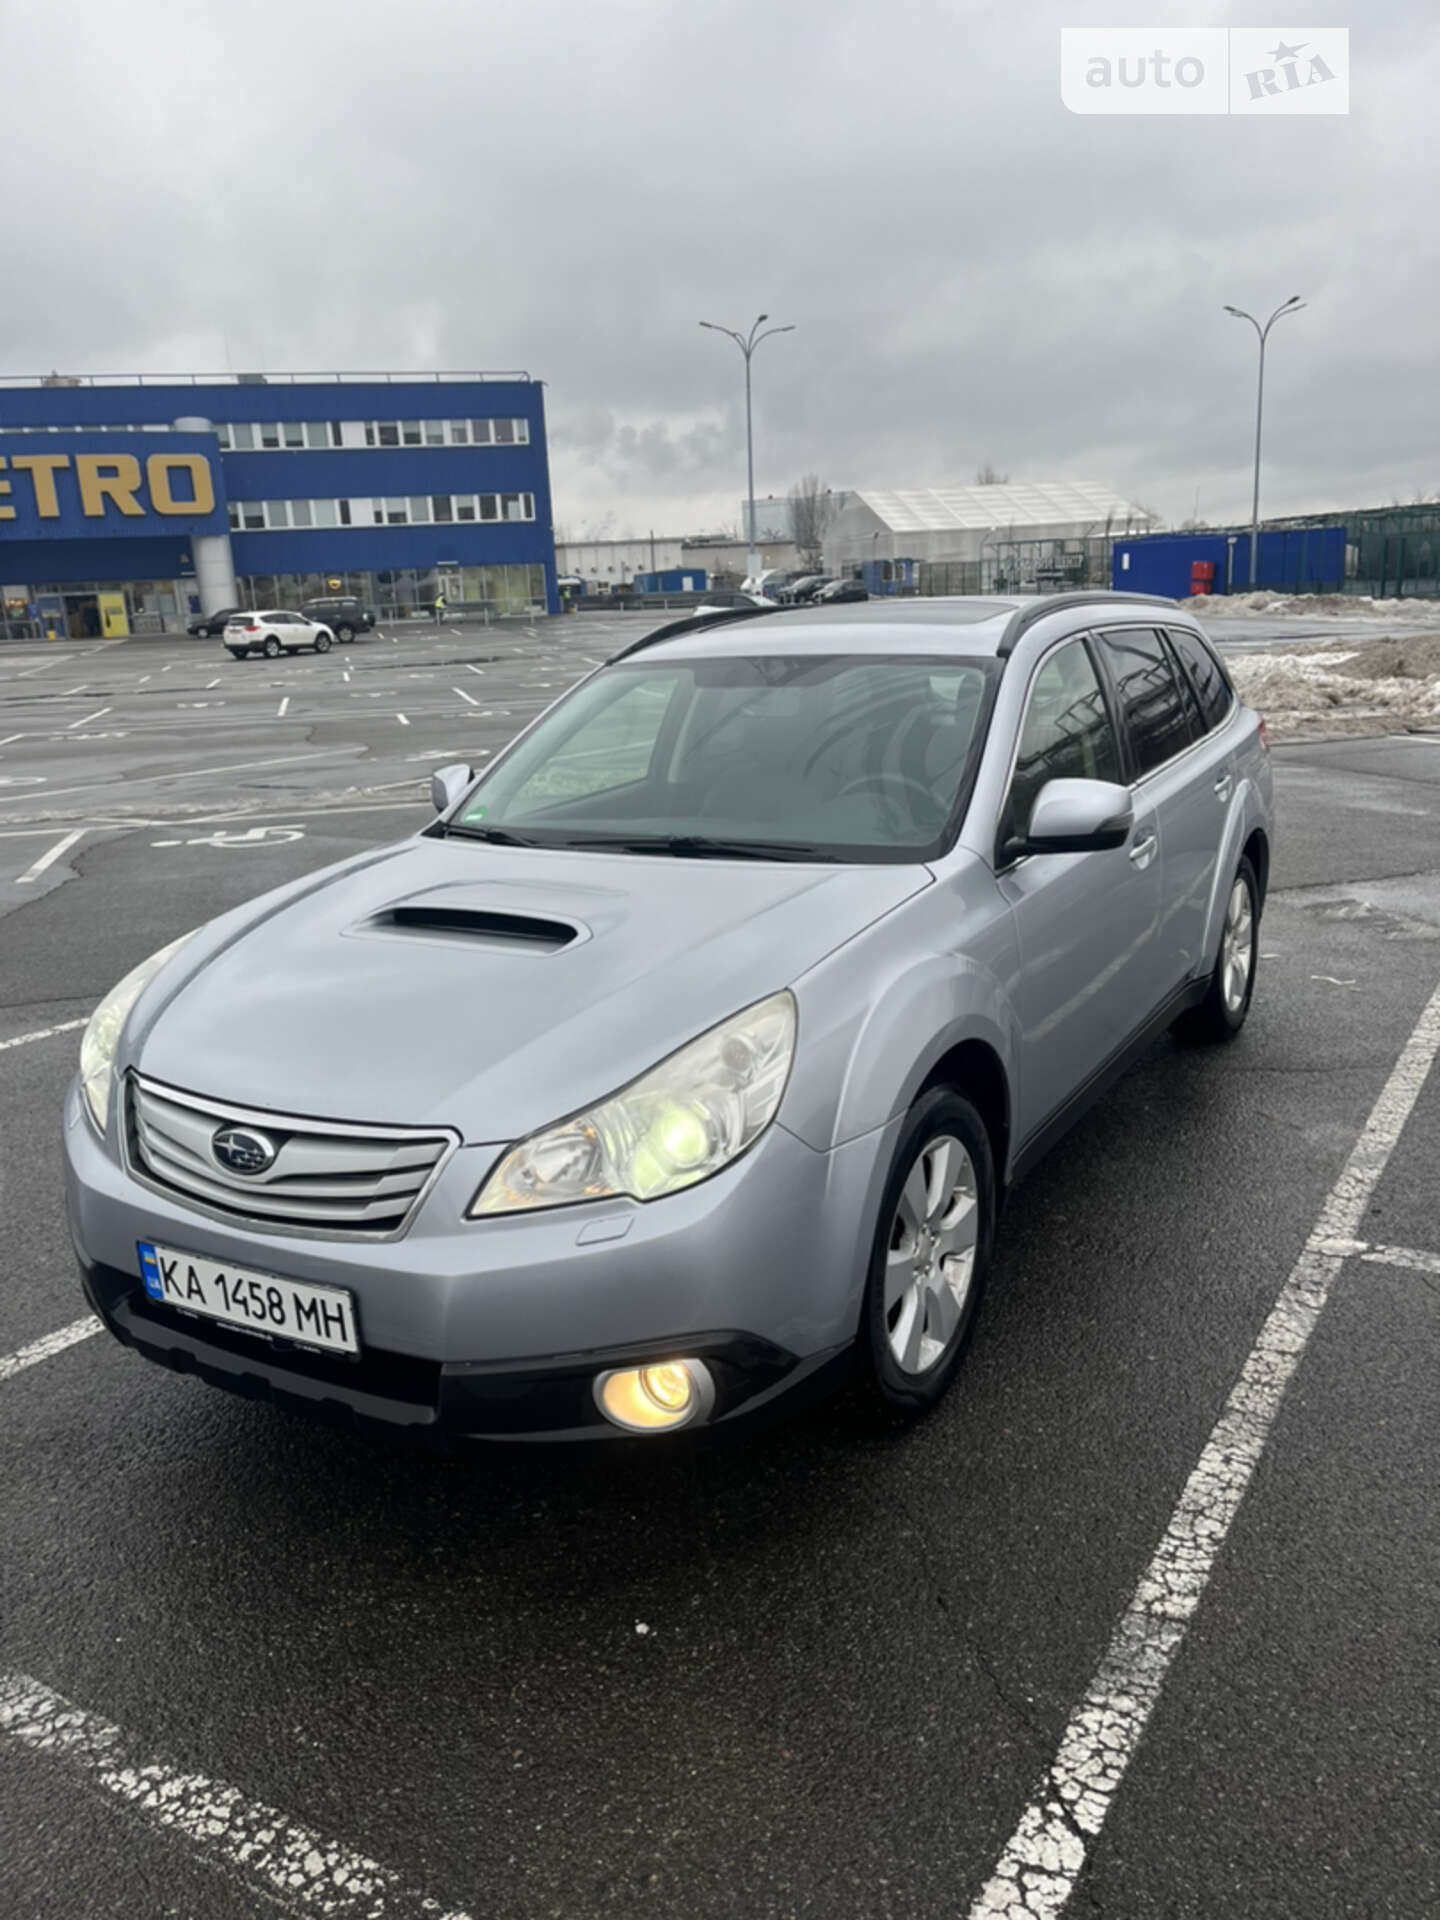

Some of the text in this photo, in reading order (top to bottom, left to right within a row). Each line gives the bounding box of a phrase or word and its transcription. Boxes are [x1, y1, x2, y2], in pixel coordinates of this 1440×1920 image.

[0, 454, 215, 518] TRO
[160, 1257, 206, 1304] KA
[215, 1274, 286, 1325] 1458
[293, 1293, 347, 1341] MH
